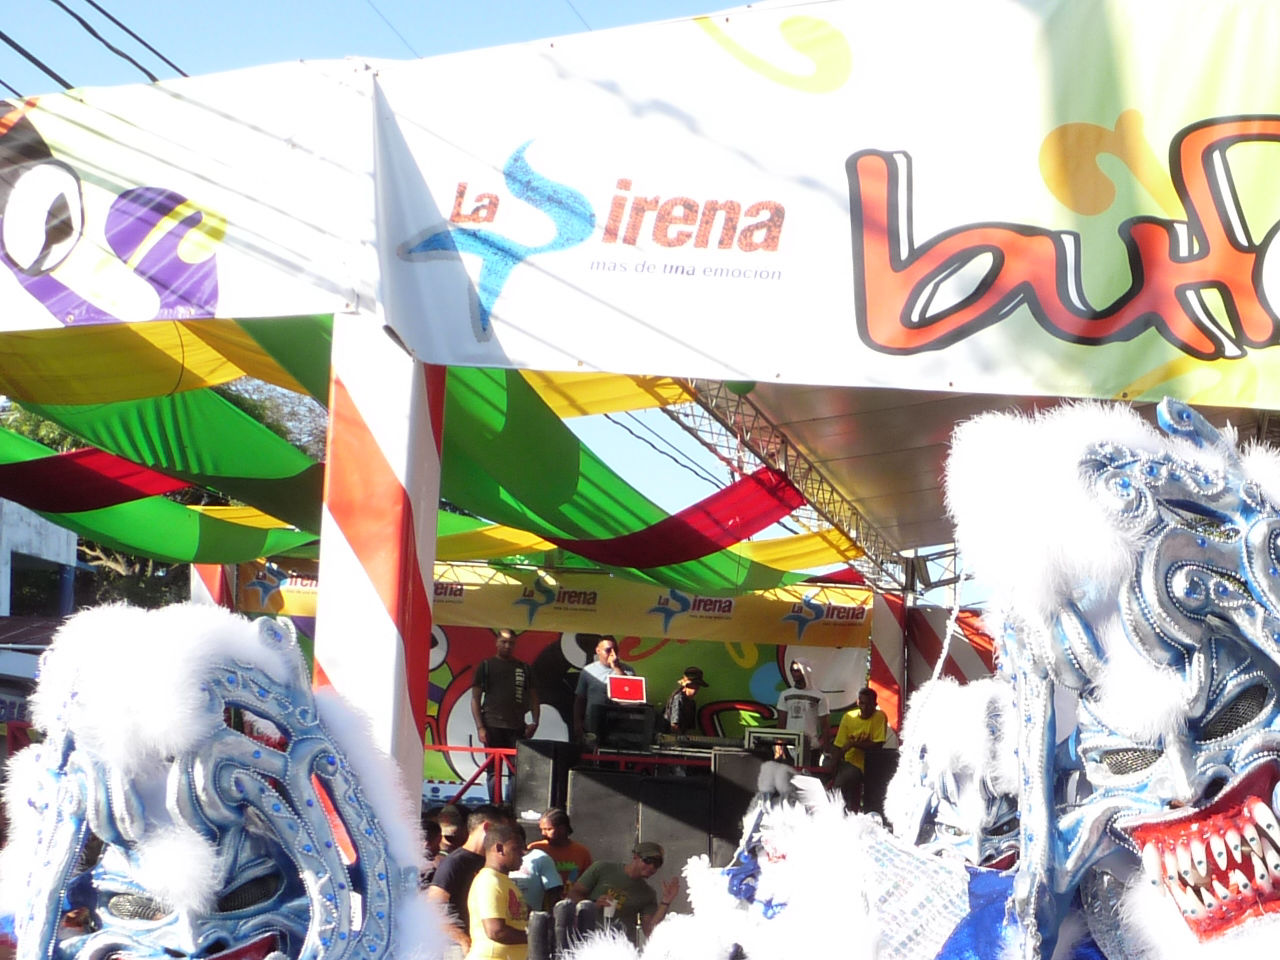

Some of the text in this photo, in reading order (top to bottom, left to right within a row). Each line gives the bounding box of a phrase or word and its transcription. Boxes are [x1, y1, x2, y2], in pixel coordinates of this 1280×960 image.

[450, 182, 500, 224] La
[634, 260, 657, 275] de
[662, 264, 697, 277] una
[523, 586, 535, 598] La
[657, 595, 669, 606] La
[792, 602, 803, 614] La
